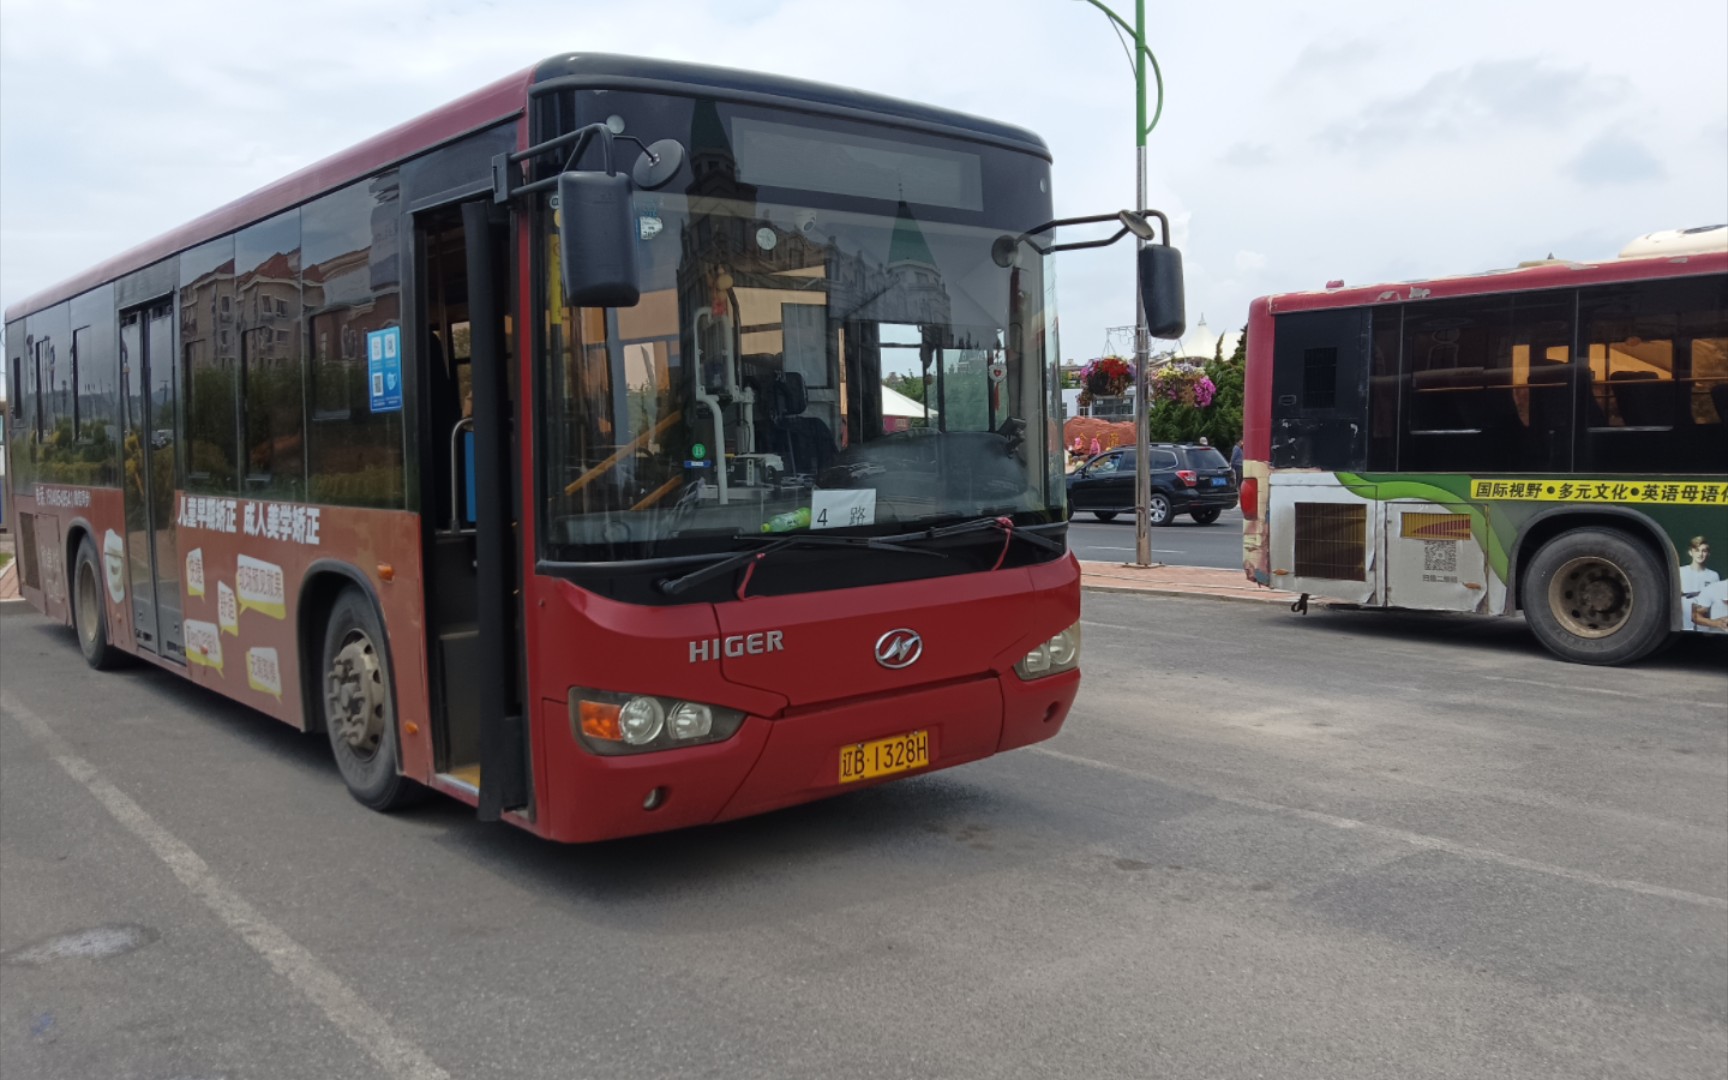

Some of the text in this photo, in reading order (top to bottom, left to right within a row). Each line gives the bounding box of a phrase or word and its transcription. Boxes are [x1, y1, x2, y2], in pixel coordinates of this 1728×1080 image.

[177, 496, 320, 545] 儿童早期矫正 成人美学矫正
[816, 505, 867, 527] 4 路
[689, 630, 785, 664] HIGER
